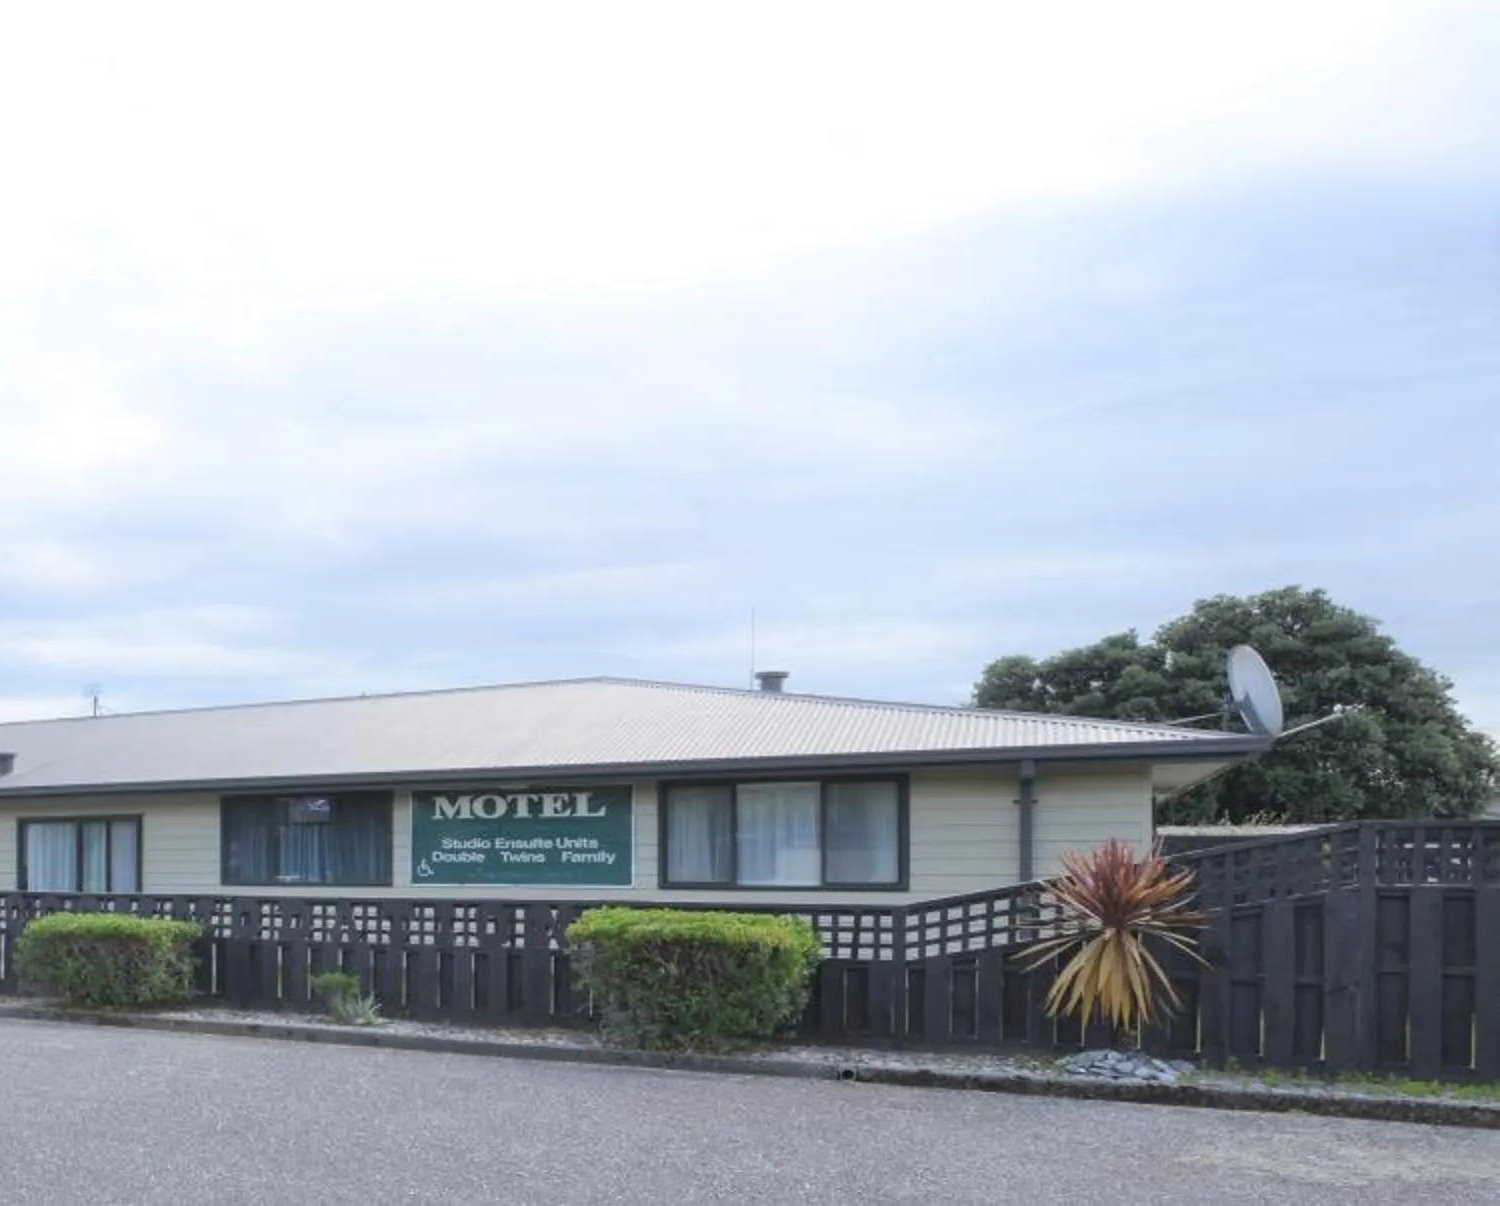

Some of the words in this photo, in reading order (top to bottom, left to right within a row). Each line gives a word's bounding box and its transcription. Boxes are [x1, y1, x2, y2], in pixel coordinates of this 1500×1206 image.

[431, 791, 607, 820] MOTEL
[441, 837, 492, 850] Studio
[495, 837, 553, 850] Ensuite
[556, 837, 599, 849] Units
[431, 851, 486, 863] Double
[500, 851, 546, 863] Twins
[561, 851, 617, 865] Family
